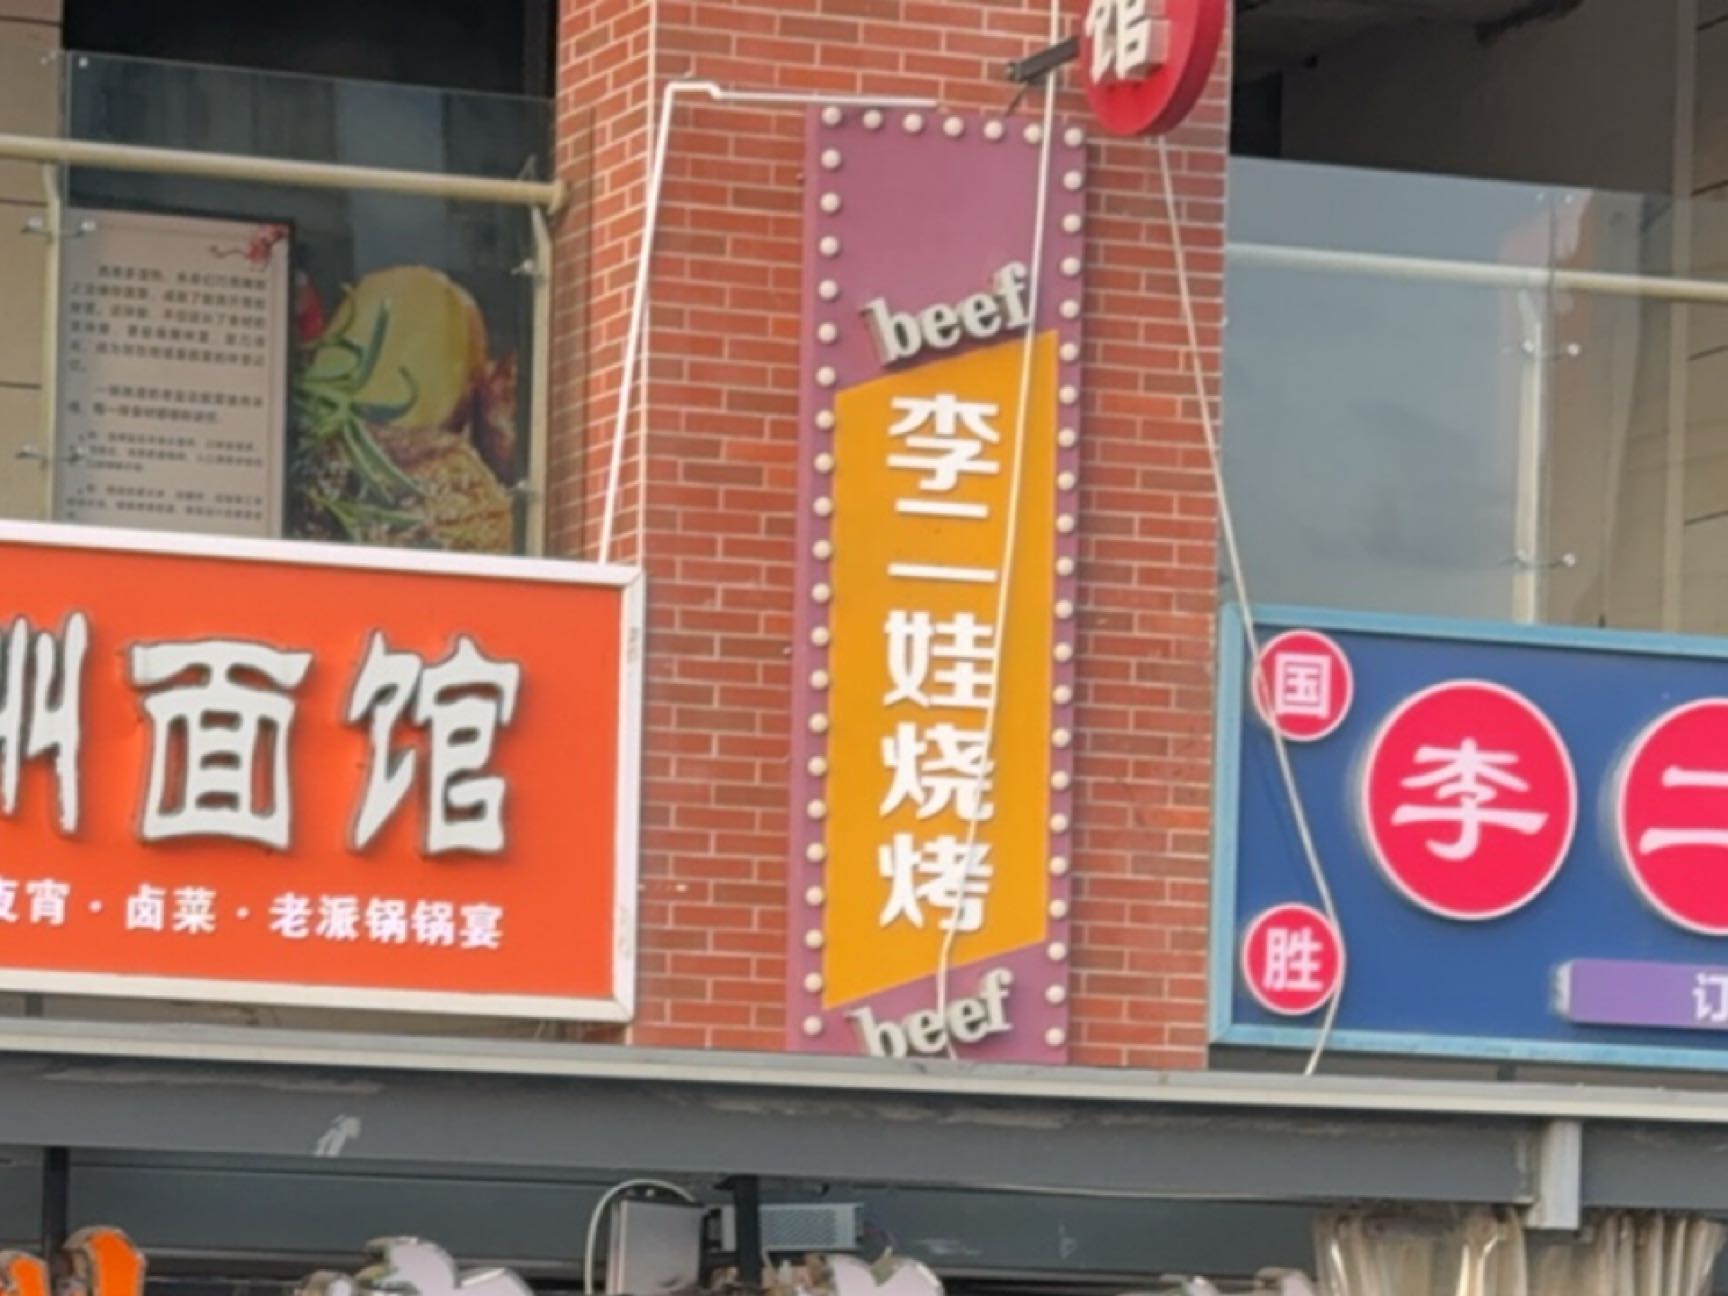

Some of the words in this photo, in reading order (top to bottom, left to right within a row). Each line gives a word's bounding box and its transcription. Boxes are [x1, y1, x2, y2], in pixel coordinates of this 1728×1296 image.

[872, 262, 1032, 364] beef
[879, 393, 1002, 934] 李二娃烧烤
[1272, 652, 1332, 718] 国
[1260, 934, 1324, 994] 胜
[854, 966, 1016, 1057] beef
